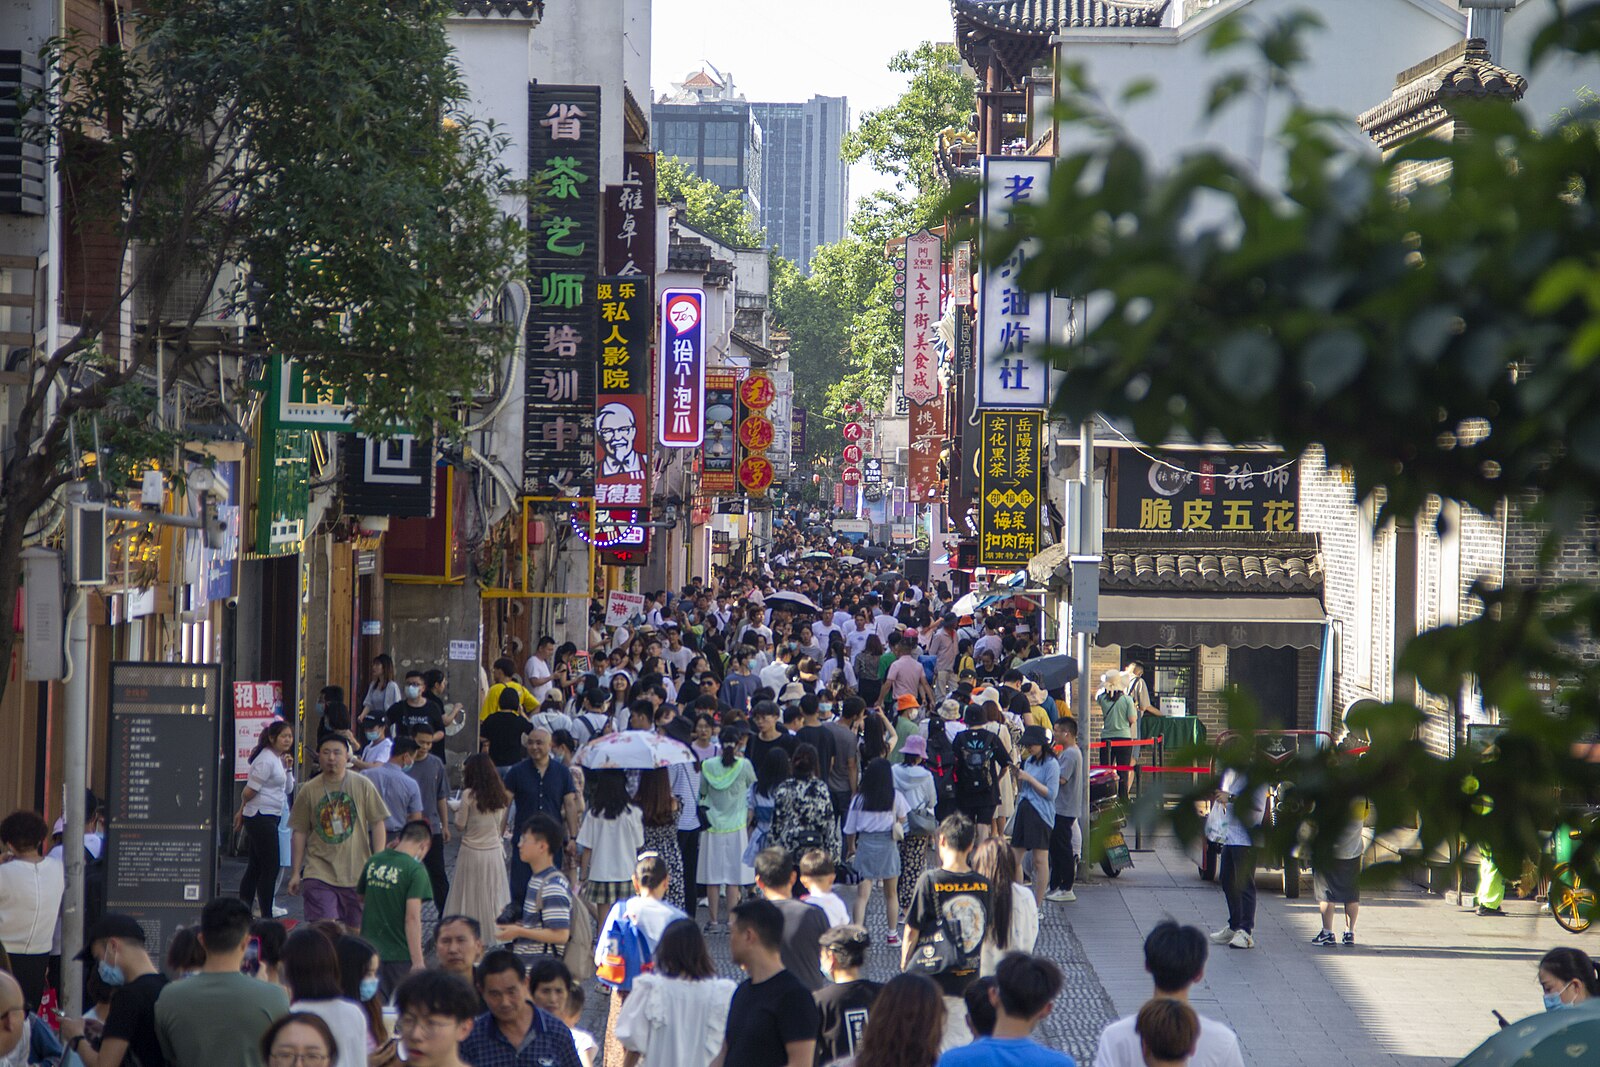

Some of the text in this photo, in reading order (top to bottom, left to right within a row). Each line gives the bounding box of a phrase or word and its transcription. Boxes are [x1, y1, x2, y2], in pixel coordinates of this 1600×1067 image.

[602, 301, 630, 389] 私人影院
[912, 272, 931, 390] 太平街美食城
[988, 416, 1008, 478] 安化黑茶
[1015, 417, 1034, 478] 岳陽茗茶
[595, 483, 643, 504] 肯德基
[994, 510, 1027, 531] 梅菜
[1139, 498, 1295, 531] 脆皮五花
[985, 531, 1035, 552] 扣肉餅
[235, 684, 274, 709] 招聘
[934, 883, 988, 892] DOLLAR
